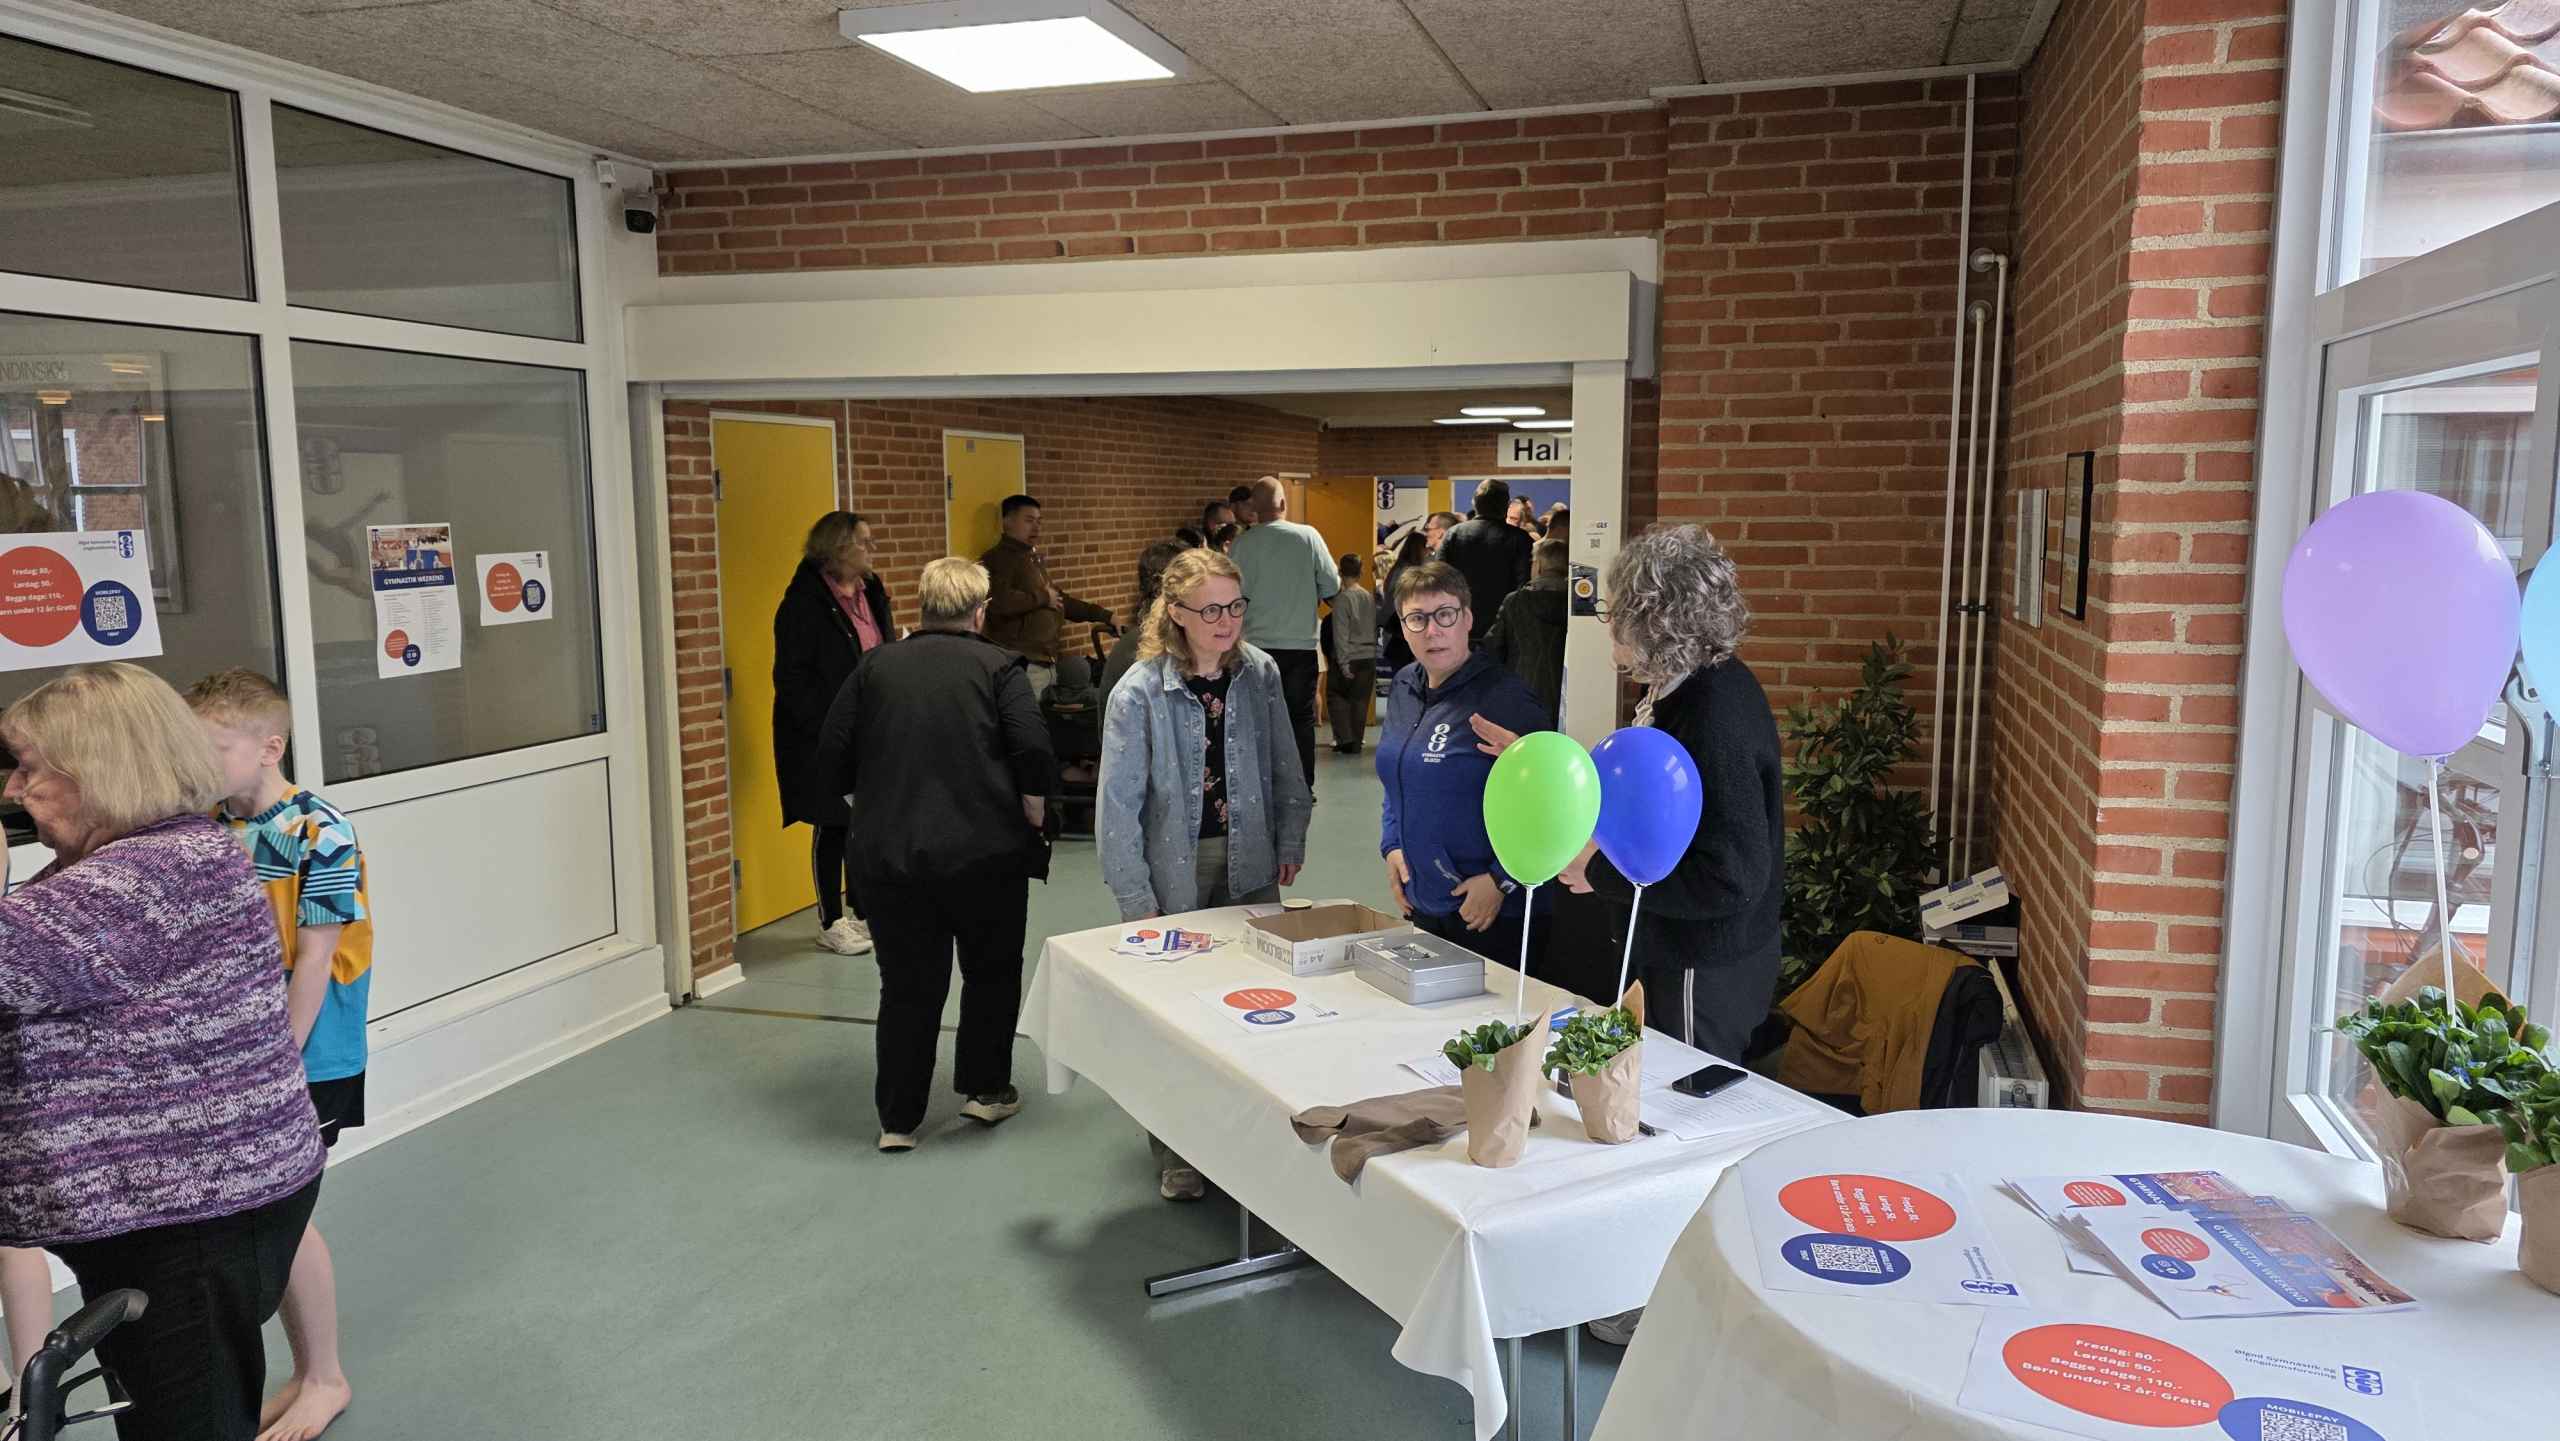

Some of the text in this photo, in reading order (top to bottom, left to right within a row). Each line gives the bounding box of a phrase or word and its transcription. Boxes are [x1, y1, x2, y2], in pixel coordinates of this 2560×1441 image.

[1514, 438, 1559, 461] Hal
[2212, 1223, 2265, 1267] GYMNASTIK
[2262, 1265, 2310, 1304] WEEKEND
[2073, 1350, 2130, 1369] Lørdag:
[2075, 1339, 2131, 1357] Fredag:
[2050, 1356, 2097, 1372] Begge
[2099, 1366, 2142, 1382] dage:
[2021, 1361, 2059, 1376] Børn
[2062, 1371, 2111, 1387] under
[2113, 1381, 2132, 1393] 12
[2160, 1391, 2211, 1410] Gratis
[2265, 1402, 2339, 1424] MOBILEPAY
